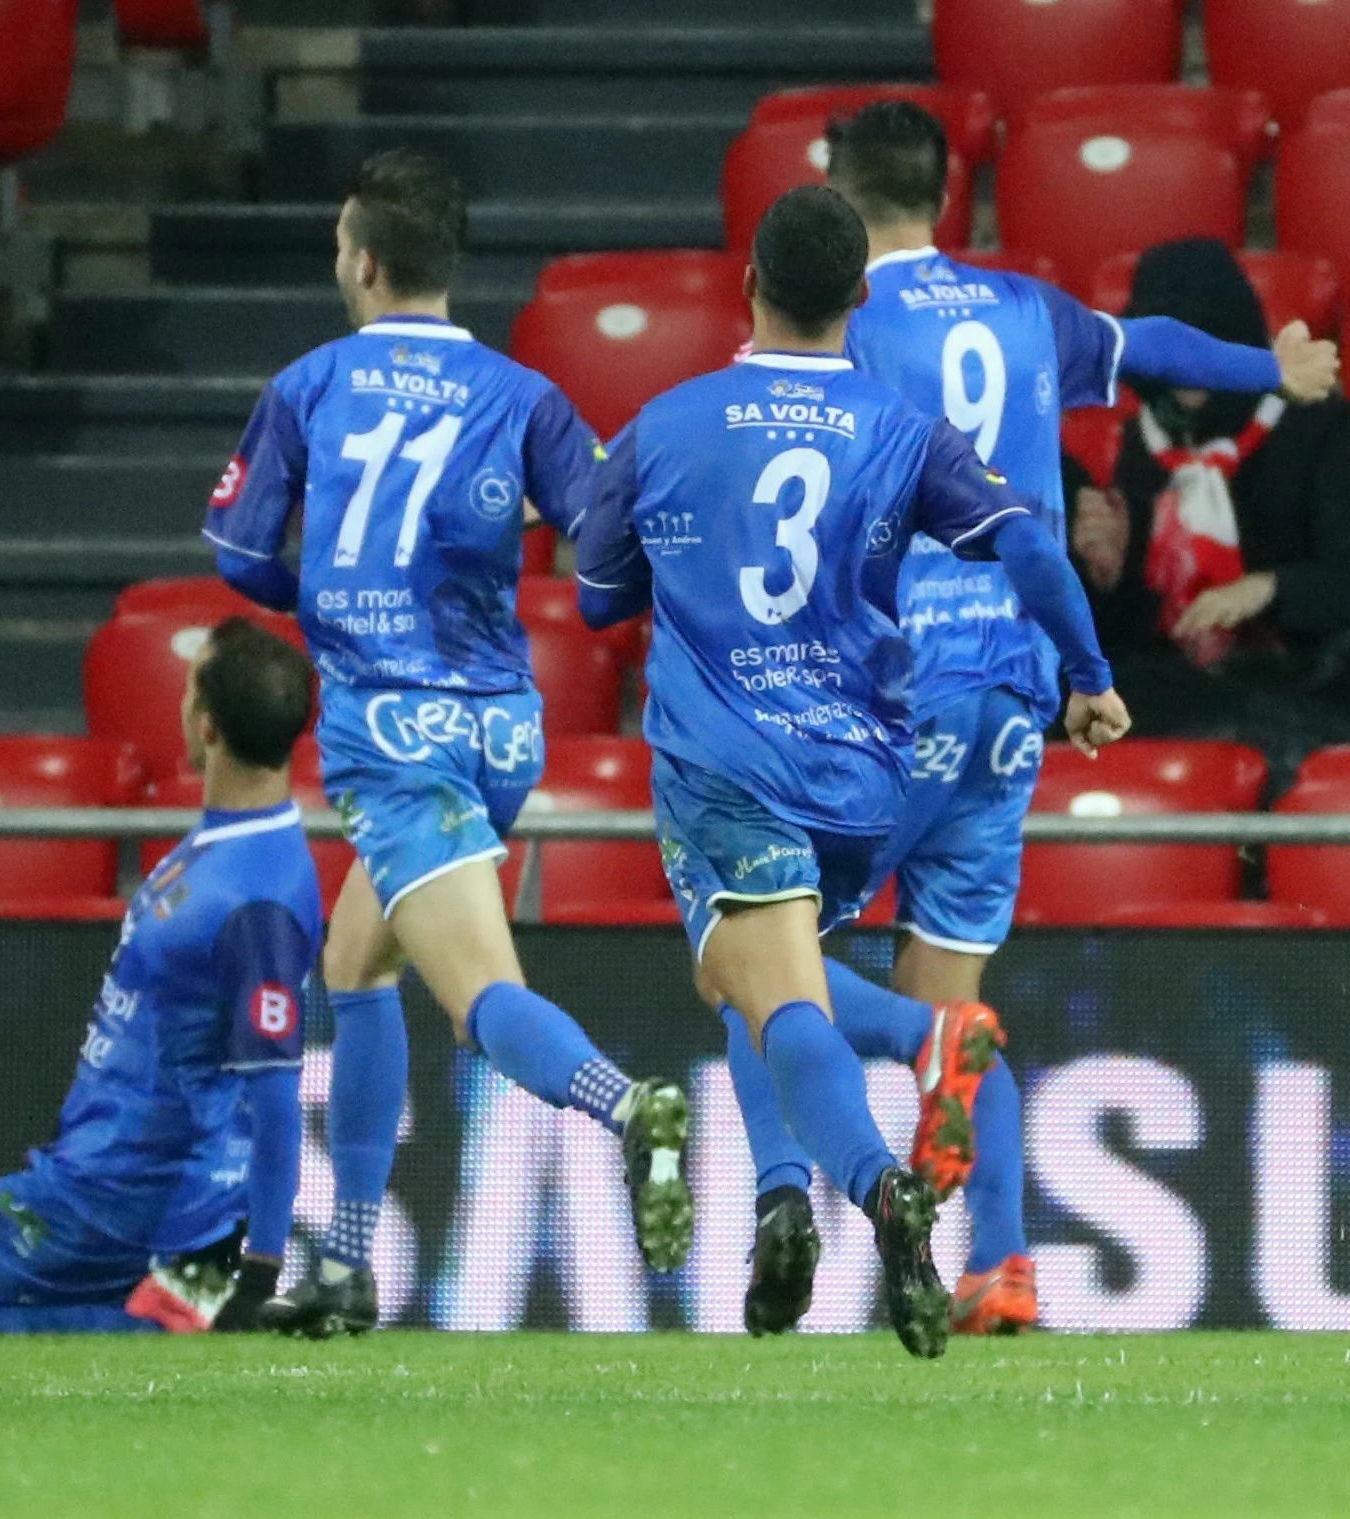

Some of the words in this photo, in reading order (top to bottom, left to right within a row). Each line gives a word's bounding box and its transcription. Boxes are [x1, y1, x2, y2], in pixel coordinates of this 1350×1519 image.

[350, 368, 386, 388] SA
[391, 370, 469, 407] VOLTA
[941, 319, 1007, 465] 9
[724, 402, 764, 424] SA
[769, 402, 856, 433] VOLTA
[332, 410, 464, 568] 11
[738, 447, 832, 626] 3
[316, 588, 349, 610] es
[729, 646, 763, 668] es
[260, 988, 288, 1033] B
